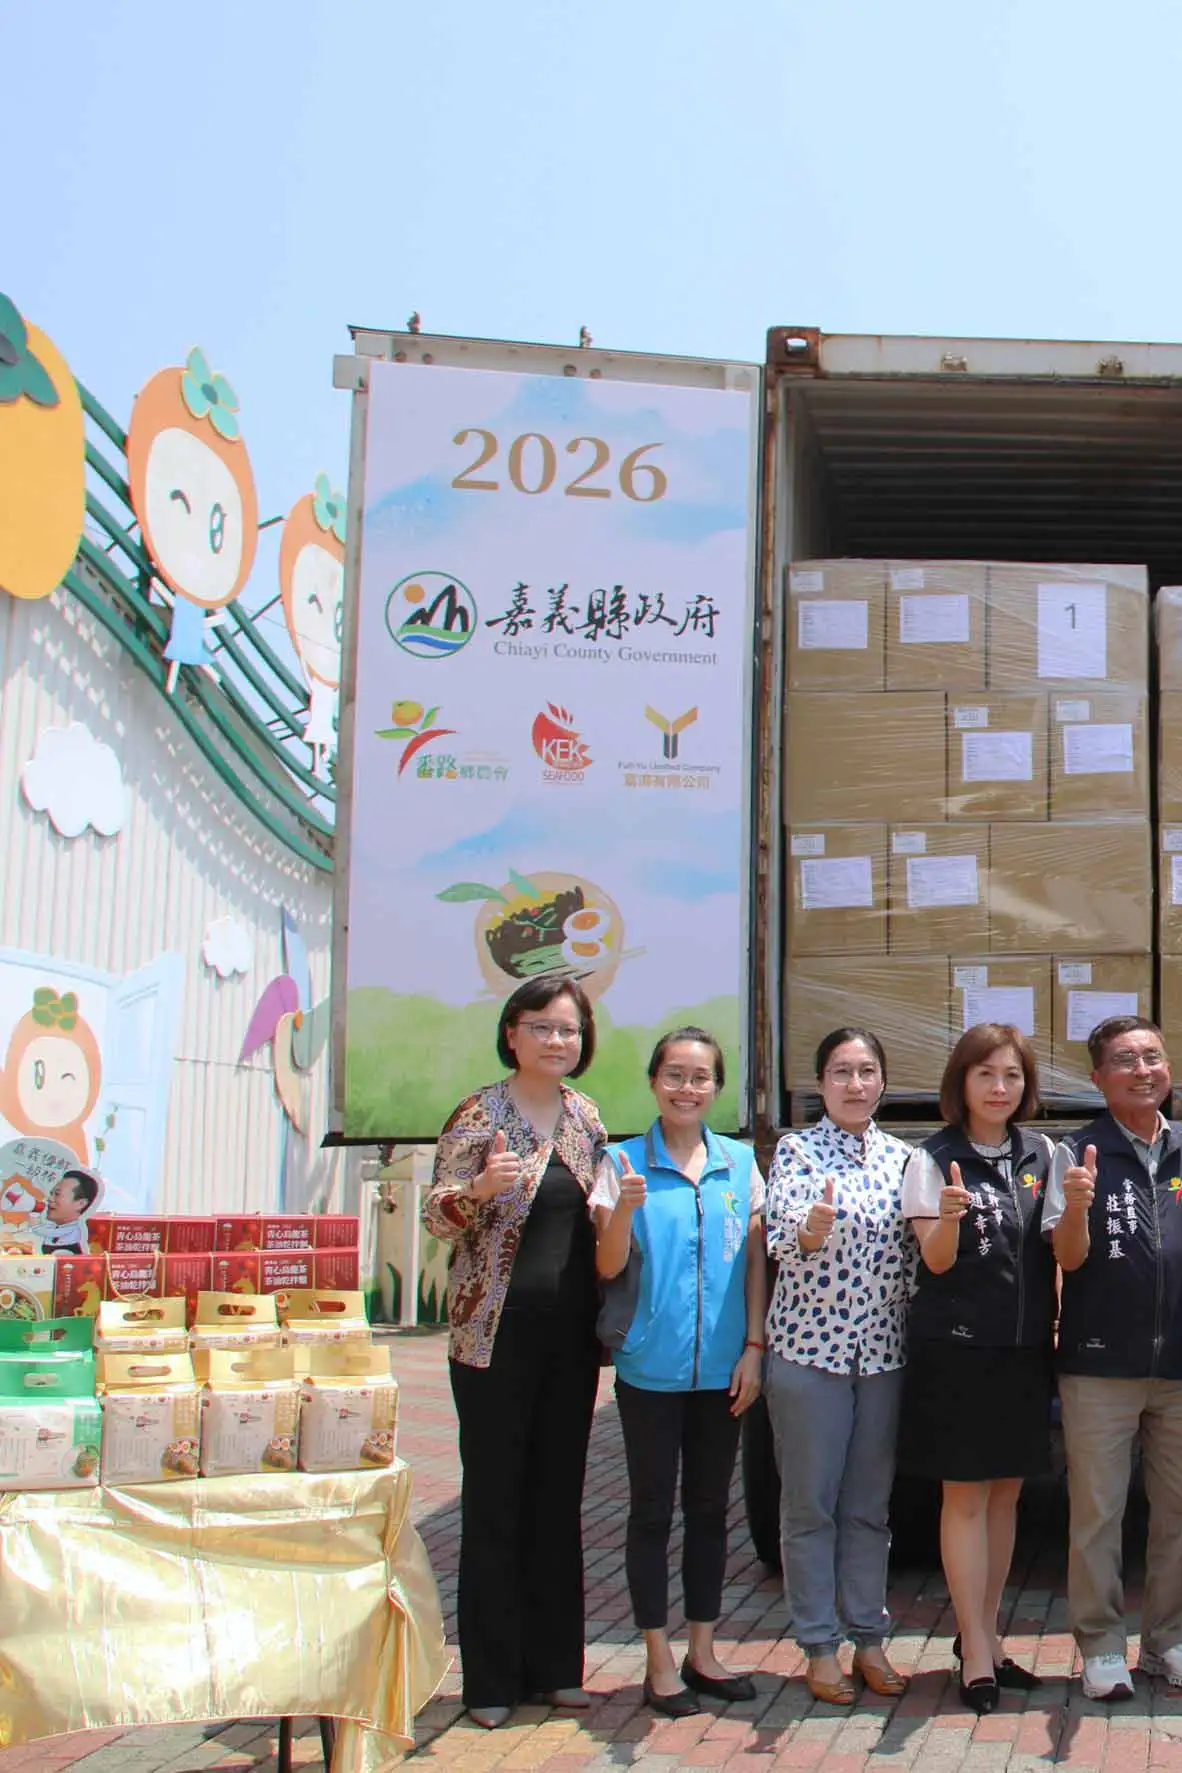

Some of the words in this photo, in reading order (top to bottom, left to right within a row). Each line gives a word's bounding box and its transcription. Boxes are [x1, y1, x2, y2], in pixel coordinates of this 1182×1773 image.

[451, 428, 668, 502] 2026
[485, 582, 720, 641] 嘉義縣政府
[1064, 603, 1075, 629] 1
[494, 640, 548, 660] Chiayi
[554, 643, 612, 663] County
[618, 646, 719, 665] Government
